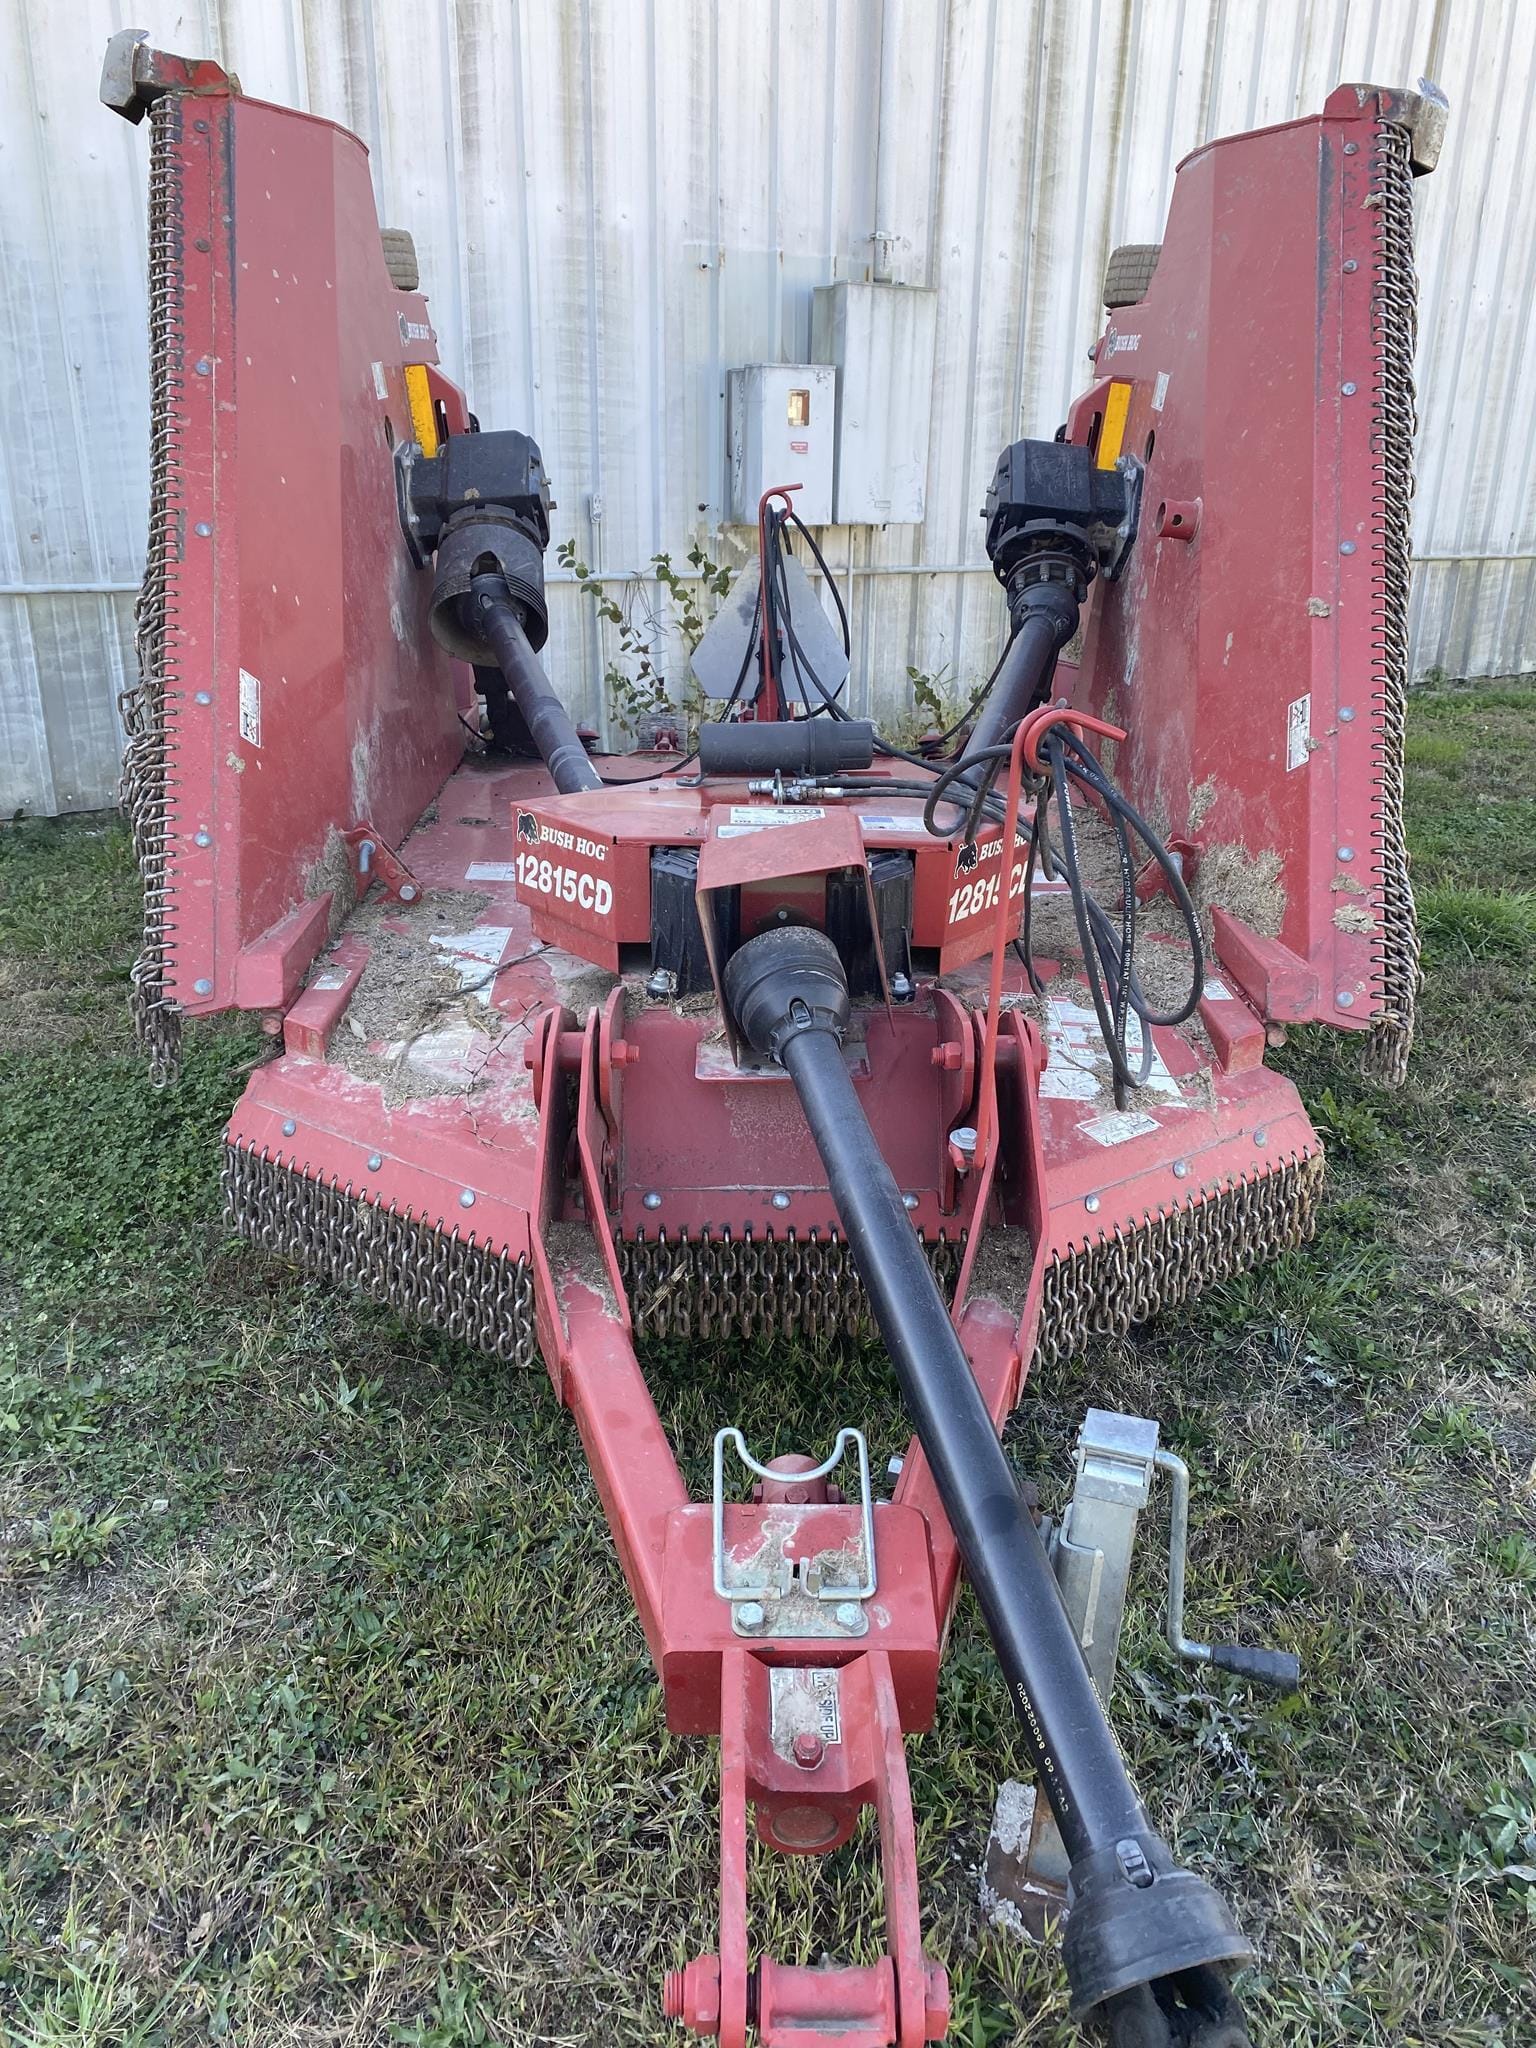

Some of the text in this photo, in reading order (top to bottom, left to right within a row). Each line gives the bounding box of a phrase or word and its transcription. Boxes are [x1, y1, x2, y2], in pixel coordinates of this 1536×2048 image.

[540, 825, 607, 861] BUSH HOG
[978, 838, 1004, 861] BUS
[516, 852, 613, 915] 12815CD
[820, 1725, 835, 1740] UP
